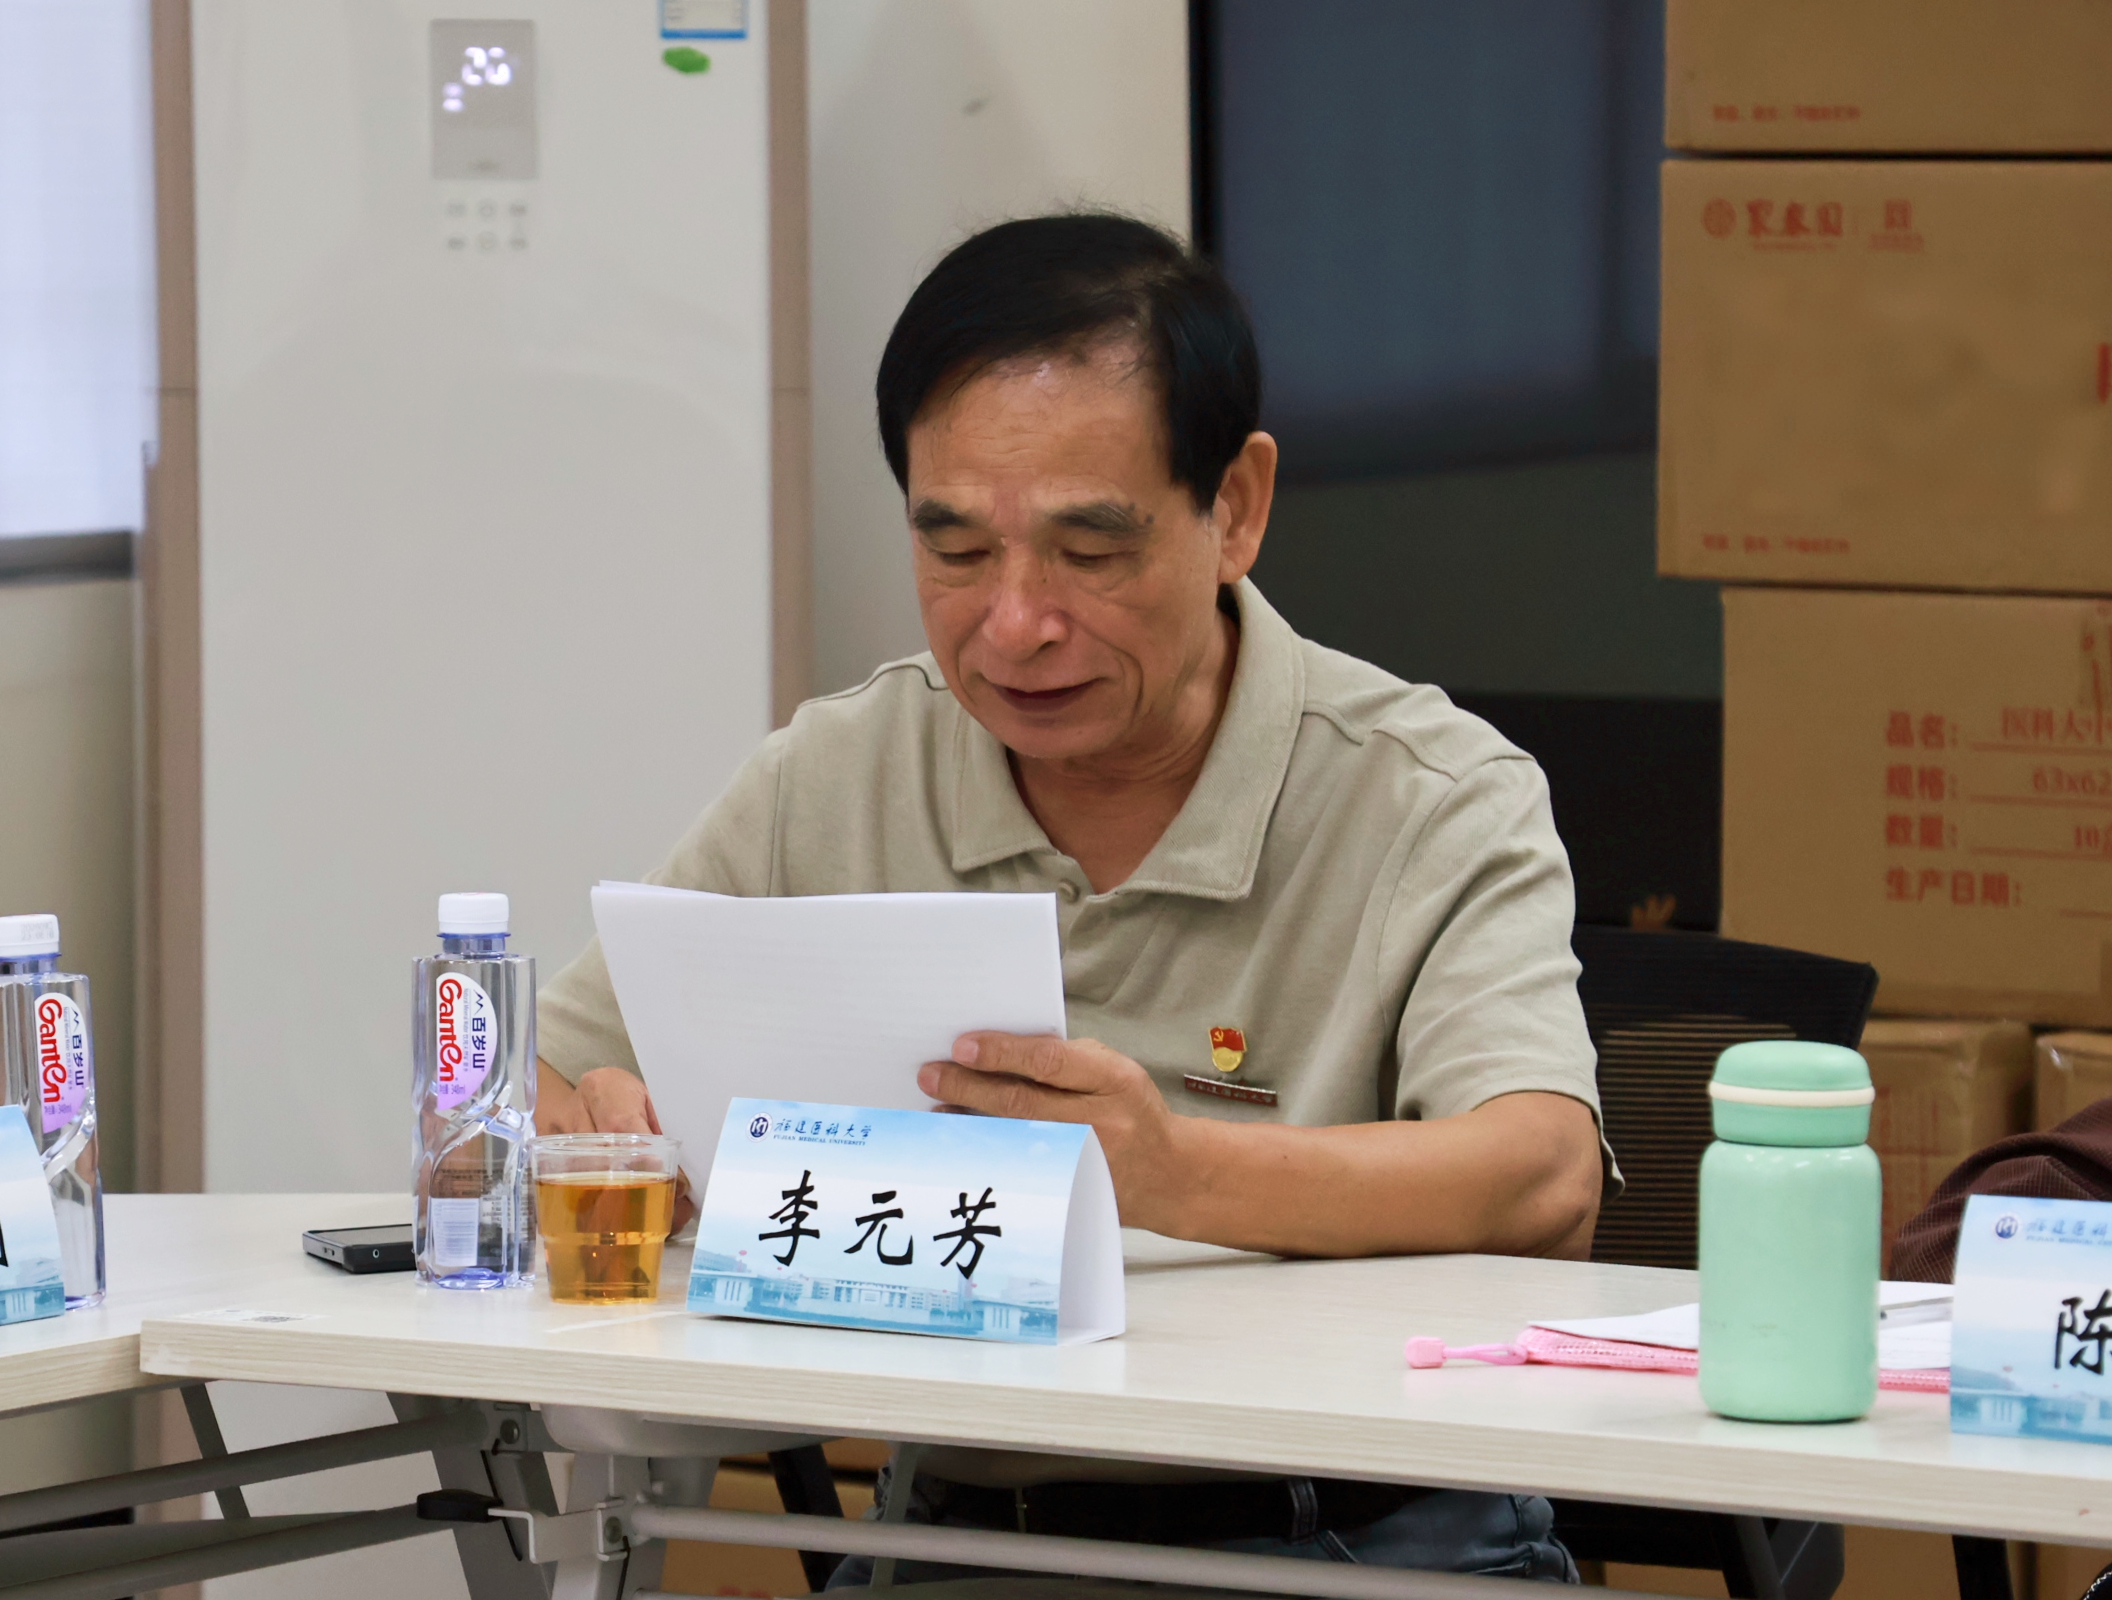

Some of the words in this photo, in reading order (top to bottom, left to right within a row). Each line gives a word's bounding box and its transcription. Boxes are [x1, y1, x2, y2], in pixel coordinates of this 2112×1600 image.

[72, 1033, 84, 1086] 百岁山
[471, 1016, 487, 1069] 百岁山
[773, 1118, 872, 1139] 福建医科大学
[773, 1134, 796, 1142] FUJIAN
[798, 1136, 827, 1144] MEDICAL
[829, 1138, 866, 1146] UNIVERSITY
[758, 1169, 1002, 1279] 李元芳
